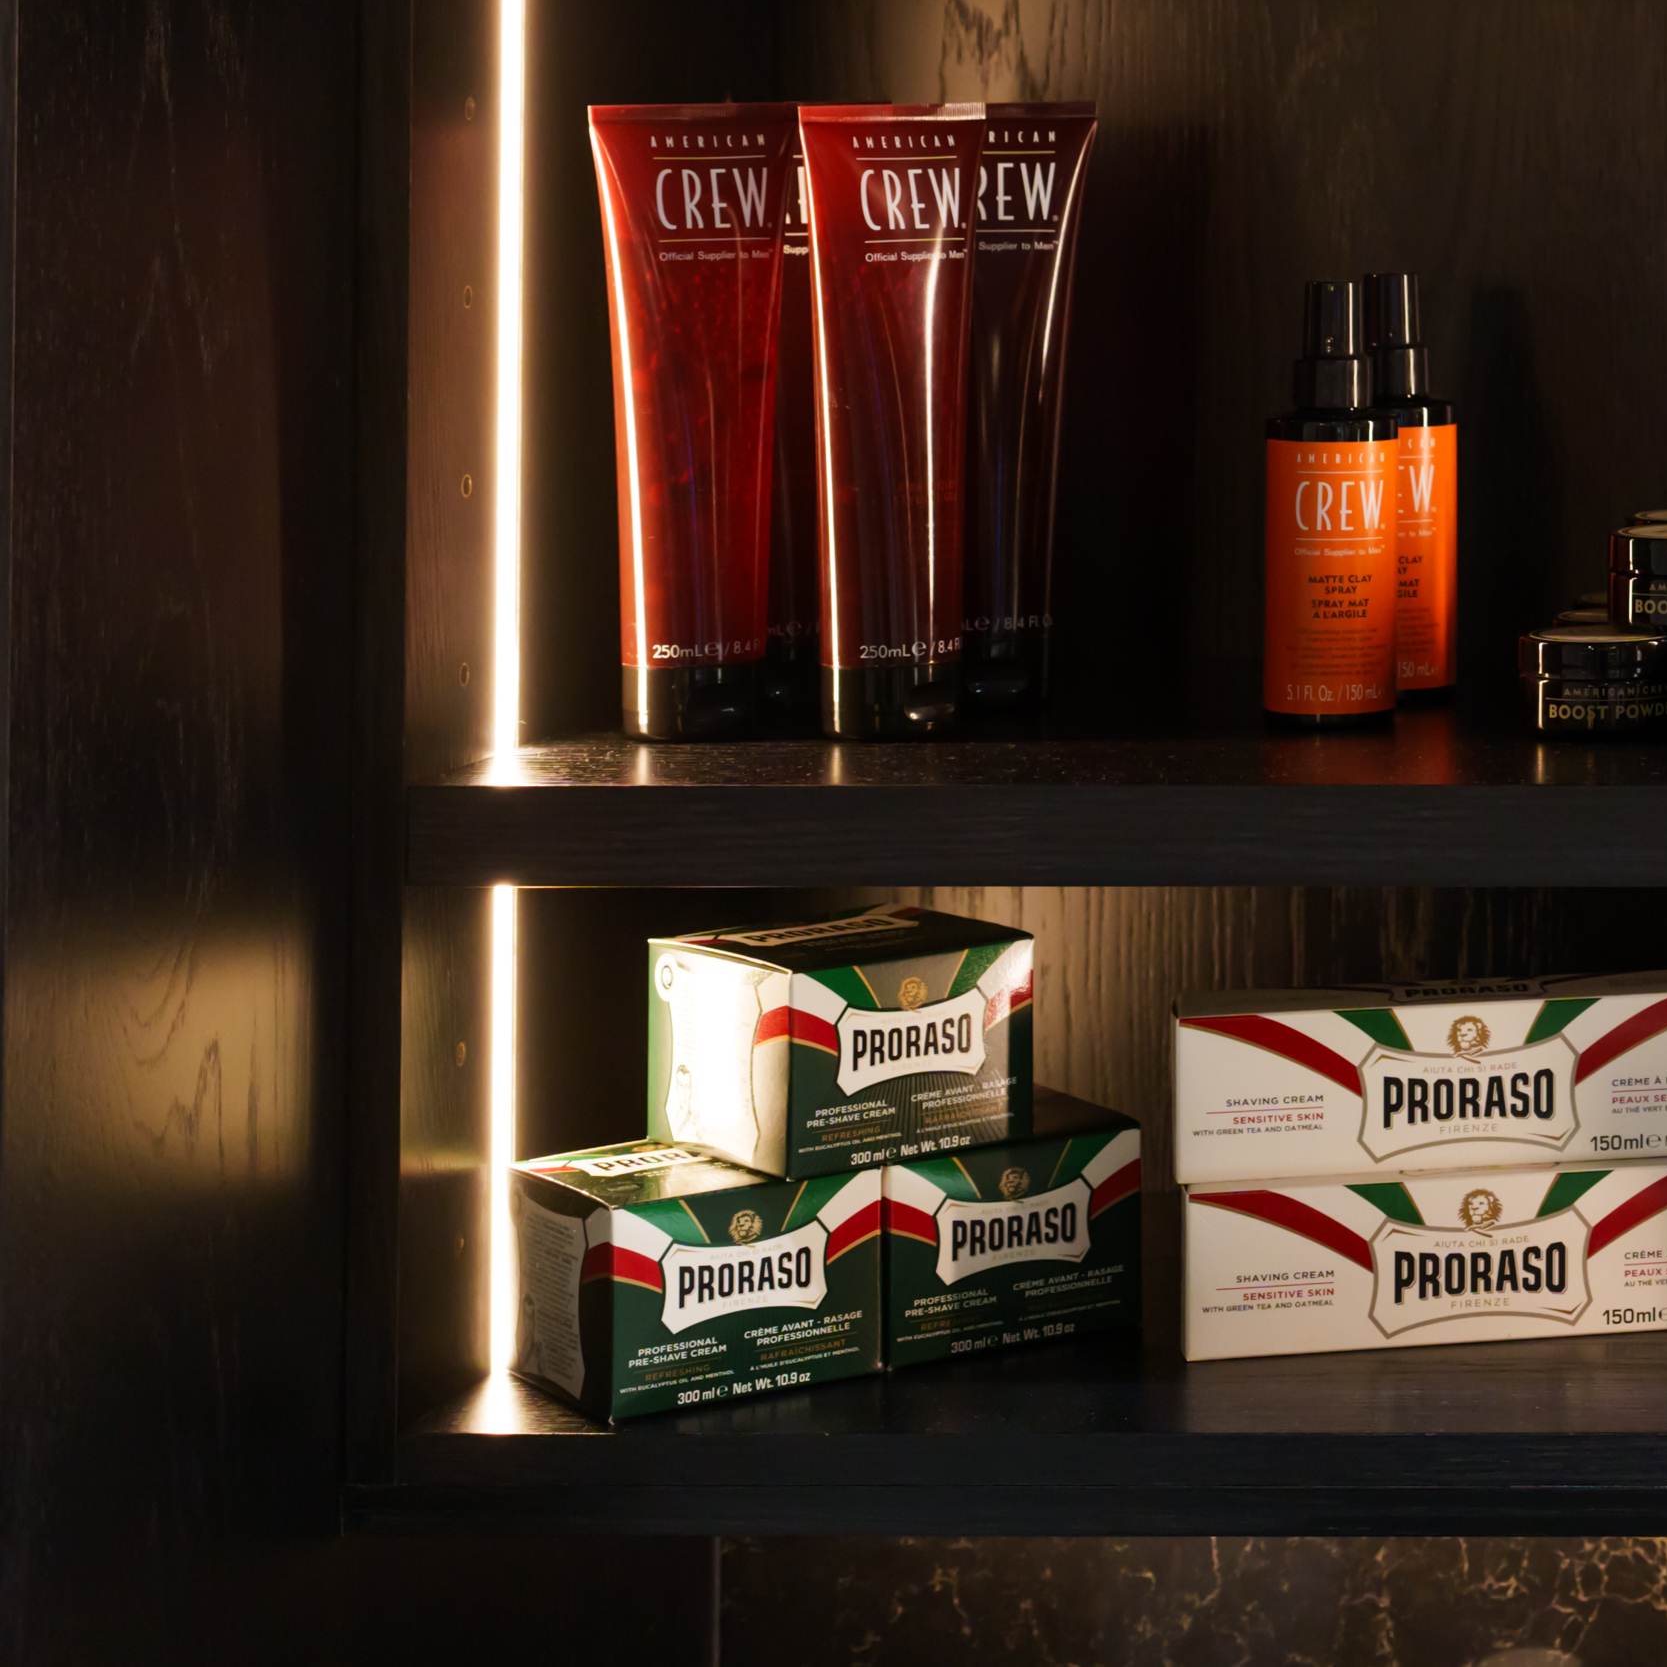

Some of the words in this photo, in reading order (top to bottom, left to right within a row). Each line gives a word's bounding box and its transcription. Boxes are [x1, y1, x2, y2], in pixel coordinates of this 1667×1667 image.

[651, 135, 765, 148] AMERICAN
[853, 135, 955, 148] AMERICAN
[656, 167, 768, 230] CREW
[860, 168, 960, 230] CREW
[976, 163, 1056, 221] REW
[978, 241, 1017, 251] Supplier
[1022, 242, 1031, 250] to
[659, 252, 694, 262] Official
[698, 251, 736, 261] Supplier
[1296, 453, 1385, 464] AMERICAN
[1295, 480, 1384, 531] CREW
[1308, 574, 1344, 584] MATTE
[1347, 574, 1373, 584] CLAY
[1324, 585, 1358, 595] SPRAY
[1311, 598, 1344, 608] SPRAY
[1347, 598, 1370, 608] MAT
[1323, 609, 1367, 619] L'ARGILE
[853, 1013, 972, 1071] PRORASO
[1226, 1096, 1278, 1107] SHAVING
[1283, 1094, 1324, 1105] CREAM
[1383, 1068, 1555, 1129] PRORASO
[1612, 1095, 1649, 1104] PEAUX
[815, 1099, 888, 1118] PROFESSIONAL
[806, 1113, 860, 1128] PRE-SHAVE
[863, 1107, 896, 1119] CREAM
[1233, 1114, 1293, 1125] SENSITIVE
[1297, 1112, 1324, 1122] SKIN
[1439, 1123, 1498, 1135] FIRENZE
[1590, 1134, 1644, 1151] 150ml
[952, 1202, 1077, 1262] PRORASO
[679, 1246, 811, 1309] PRORASO
[1236, 1272, 1289, 1283] SHAVING
[1293, 1270, 1335, 1280] CREAM
[1394, 1241, 1567, 1305] PRORASO
[1243, 1290, 1303, 1301] SENSITIVE
[1308, 1288, 1335, 1297] SKIN
[1451, 1298, 1510, 1310] FIRENZE
[781, 1319, 815, 1334] AVANT
[824, 1311, 863, 1324] RASAGE
[757, 1322, 851, 1346] PROFESSIONNELLE
[638, 1337, 718, 1357] PROFESSIONAL
[628, 1351, 688, 1369] PRE-SHAVE
[691, 1345, 727, 1358] CREAM
[677, 1391, 700, 1405] 300
[702, 1387, 715, 1401] ml
[733, 1380, 753, 1394] Net
[755, 1377, 775, 1391] Wt.
[775, 1371, 798, 1386] 10.9
[799, 1372, 811, 1383] oz
